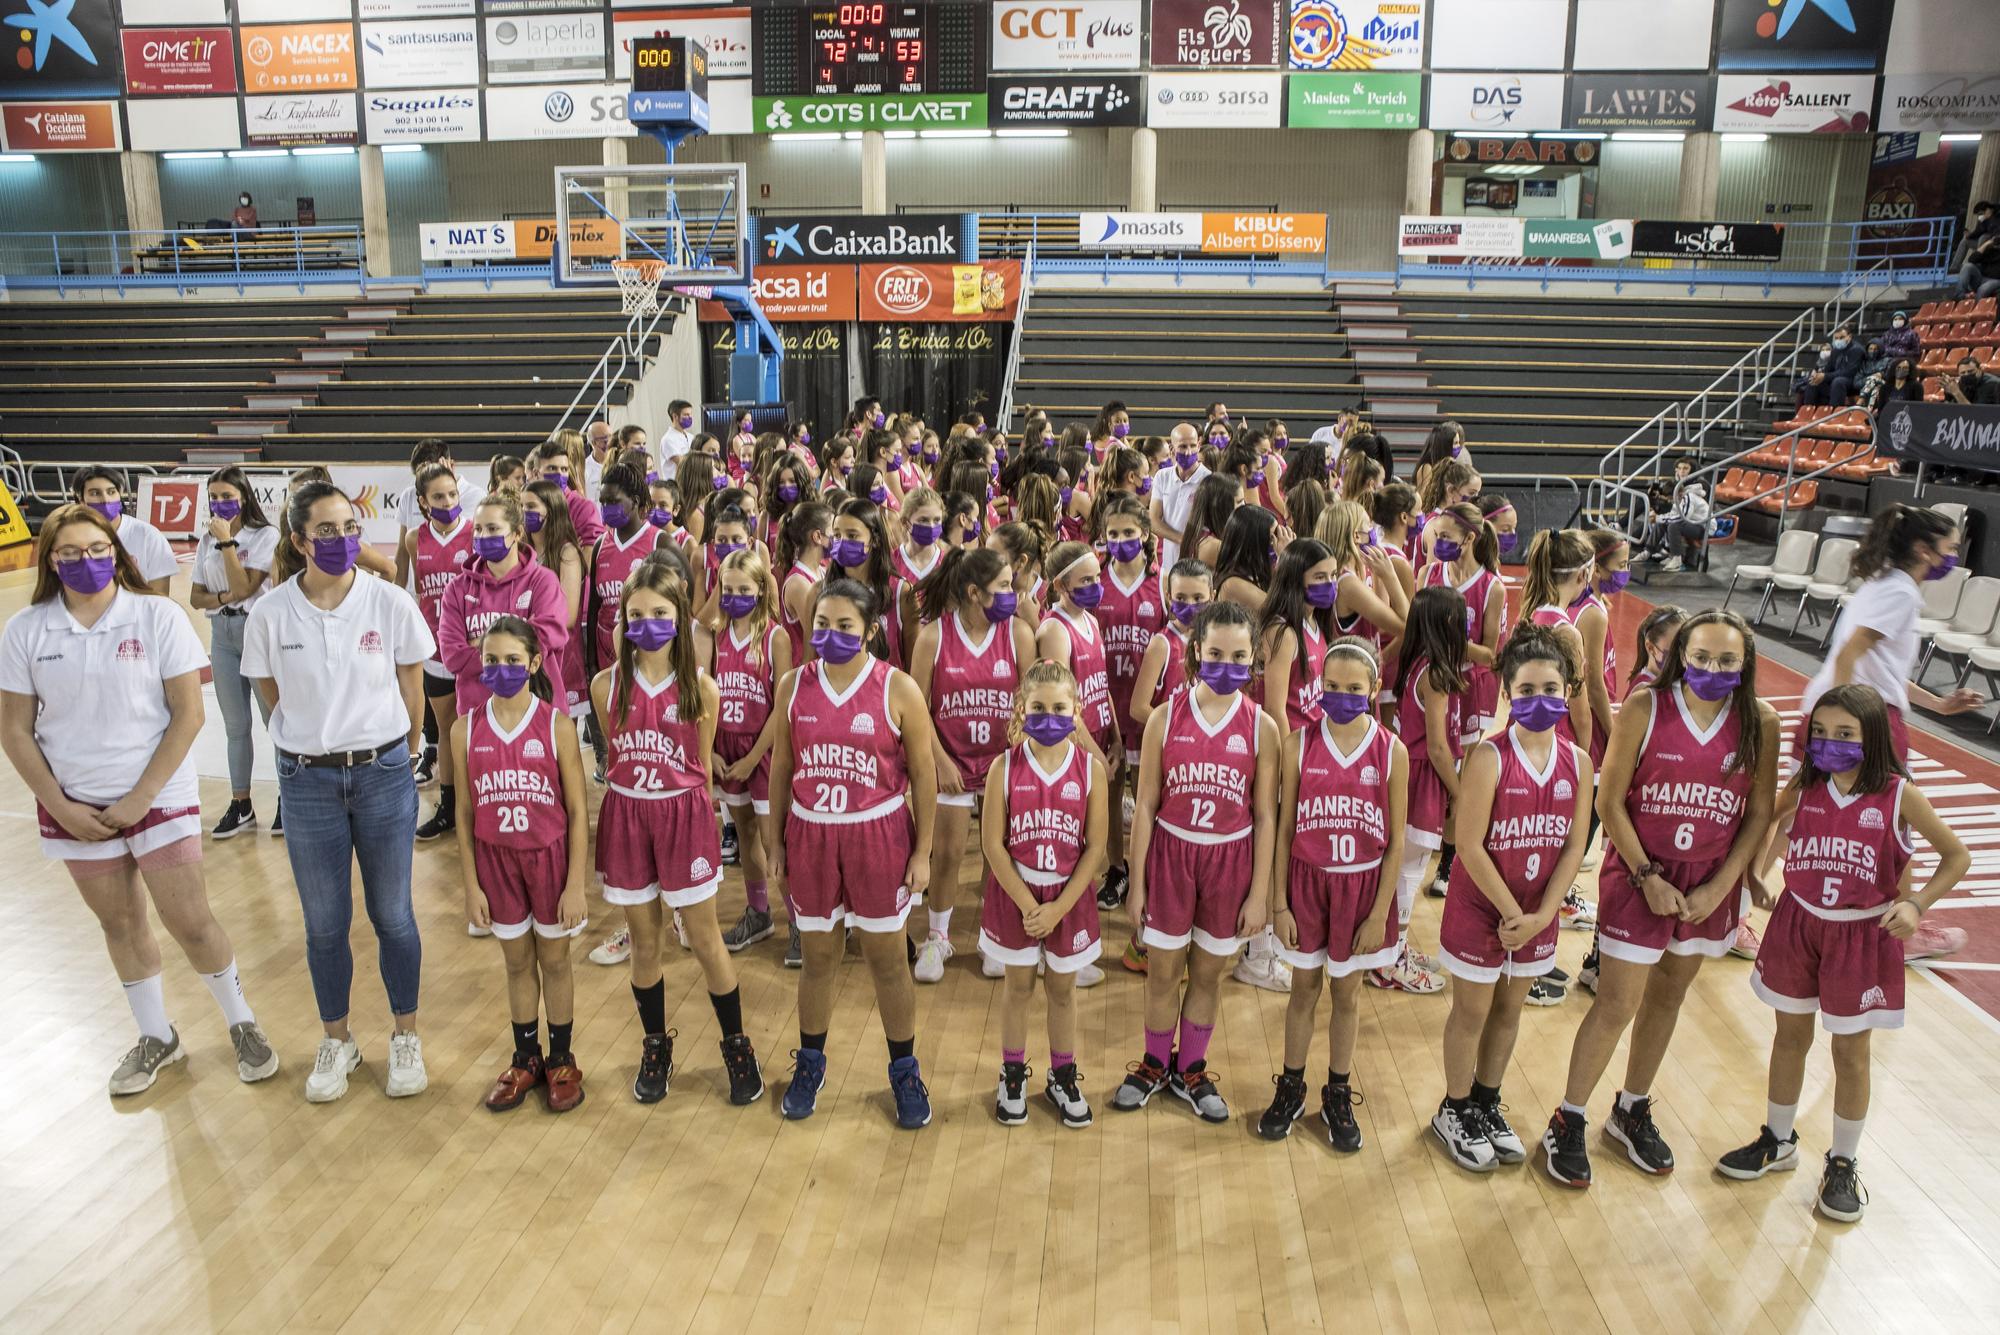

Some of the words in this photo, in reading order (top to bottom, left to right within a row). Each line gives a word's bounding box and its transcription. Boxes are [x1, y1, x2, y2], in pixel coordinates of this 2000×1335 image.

[1379, 4, 1420, 14] QUALITAT
[388, 31, 474, 46] santasusana
[815, 29, 846, 40] LOCAL
[889, 27, 921, 39] VISITANT
[1000, 8, 1084, 40] GCT
[1086, 15, 1134, 49] plus
[1177, 28, 1206, 46] Els
[281, 33, 350, 56] NACEX
[823, 42, 848, 63] 72
[896, 41, 922, 62] 53
[1177, 45, 1252, 66] Noguers
[821, 68, 832, 83] 4
[904, 66, 916, 82] 2
[815, 84, 838, 94] FALTES
[853, 83, 882, 94] JUGADOR
[899, 83, 922, 93] FALTES
[1003, 86, 1104, 110] CRAFT
[1218, 90, 1270, 105] sarsa
[1352, 82, 1365, 96] &
[1473, 87, 1522, 105] DAS
[254, 99, 278, 121] La
[370, 95, 474, 113] Sagalés
[654, 100, 684, 111] Movistar
[1583, 88, 1697, 115] LAWES
[1784, 93, 1852, 108] SALLENT
[44, 112, 85, 123] Catalana
[395, 117, 411, 125] 902
[414, 116, 423, 125] 13
[426, 116, 438, 124] 00
[801, 102, 864, 125] COTS
[880, 101, 973, 122] CLARET
[1003, 110, 1046, 120] FUNCTIONAL
[1047, 109, 1094, 120] SPORTSWEAR
[1577, 117, 1601, 126] ESTUDI
[1628, 118, 1649, 126] PENAL
[45, 122, 86, 134] Occident
[383, 124, 464, 135] www.sagales.com
[1477, 140, 1567, 162] BAR
[1867, 203, 1915, 219] BAXI
[1121, 219, 1184, 236] masats
[1234, 216, 1294, 232] KIBUC
[808, 224, 957, 256] CaixaBank
[1205, 233, 1259, 249] Albert
[1261, 233, 1323, 253] Disseny
[1675, 230, 1687, 244] la
[1685, 232, 1736, 254] Soca
[806, 271, 828, 298] id
[883, 276, 925, 294] FRIT
[887, 293, 920, 304] RAVICH
[766, 303, 782, 313] code
[782, 304, 797, 316] you
[797, 304, 810, 313] can
[810, 303, 828, 313] trust
[1114, 654, 1135, 678] 14
[940, 688, 1015, 712] MANRESA
[722, 700, 745, 724] 25
[939, 709, 958, 720] CLUB
[1097, 701, 1112, 728] 15
[967, 719, 991, 745] 18
[612, 728, 687, 762] MANRESA
[632, 766, 665, 793] 24
[1165, 761, 1247, 796] MANRESA
[813, 782, 848, 814] 20
[1181, 781, 1222, 798] BÀSQUET
[496, 804, 529, 834] 26
[1190, 797, 1217, 830] 12
[1296, 794, 1385, 831] MANRESA
[1640, 802, 1661, 815] CLUB
[1661, 802, 1711, 819] BÀSQUET
[1010, 806, 1081, 836] MANRESA
[1296, 817, 1318, 834] CLUB
[1318, 815, 1359, 831] BÀSQUET
[1009, 832, 1029, 848] CLUB
[1487, 838, 1512, 852] CLUB
[1673, 822, 1696, 852] 6
[1035, 844, 1058, 871] 18
[1328, 833, 1356, 864] 10
[1786, 836, 1879, 872] MANRES
[1524, 852, 1542, 882] 9
[1785, 860, 1811, 873] CLUB
[1811, 859, 1855, 876] BÀSQUET
[1821, 876, 1843, 907] 5
